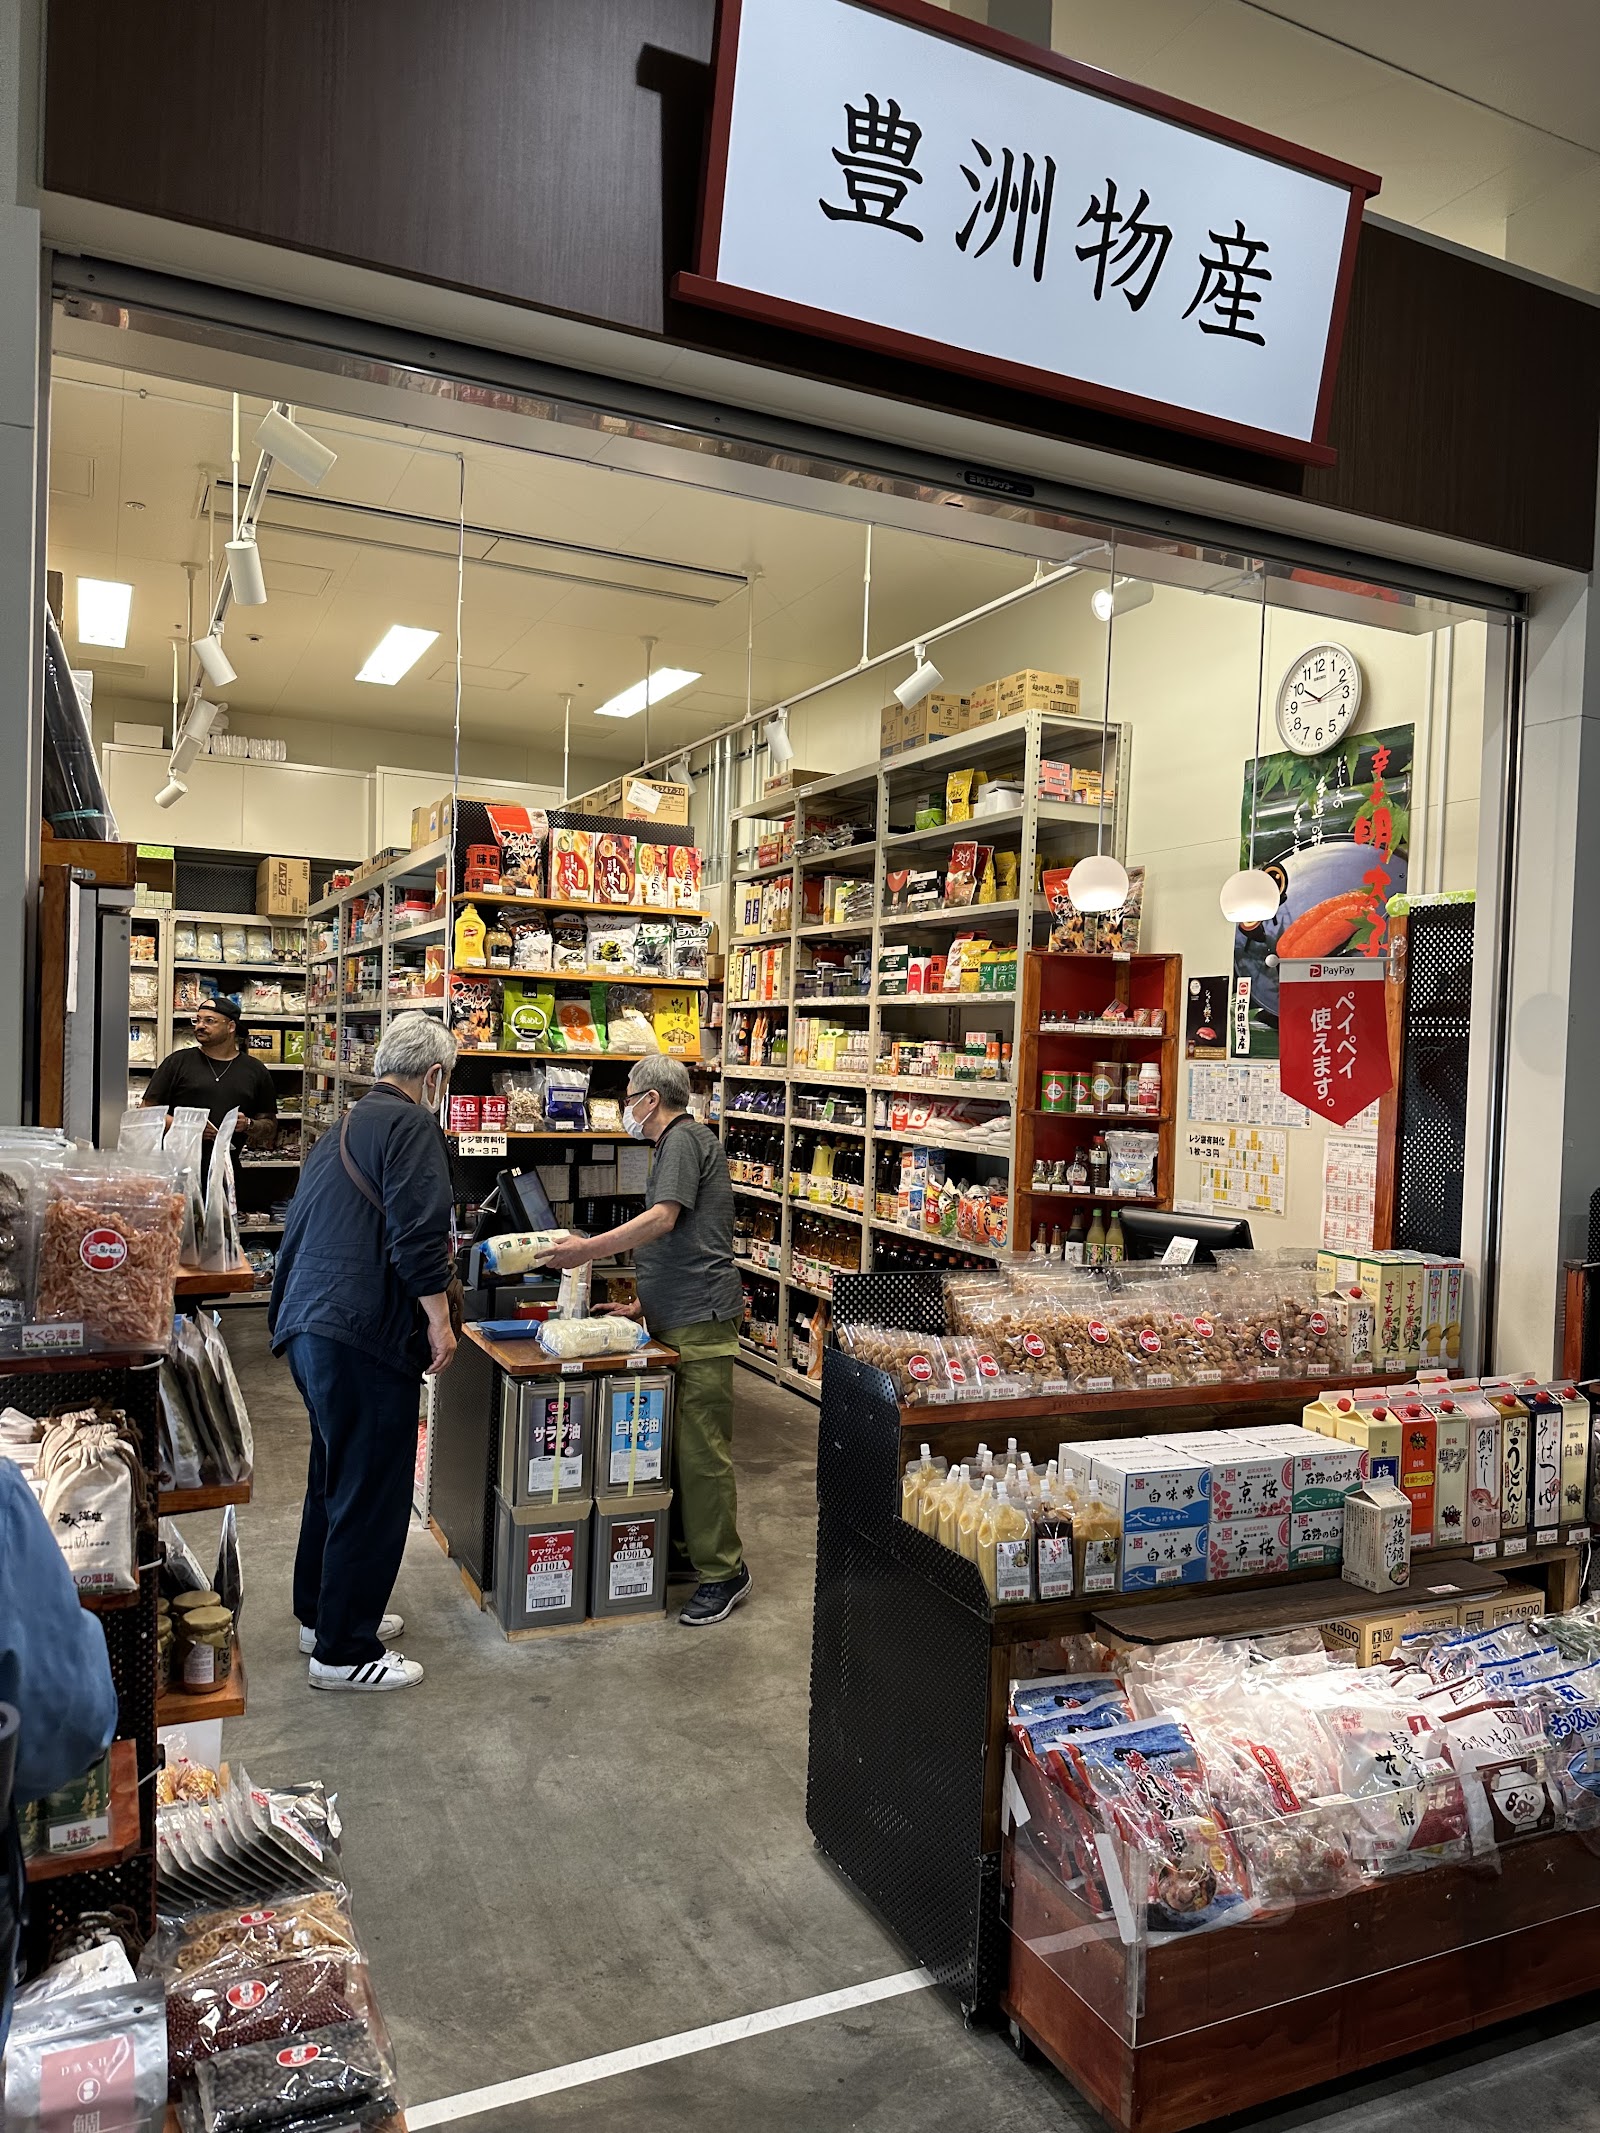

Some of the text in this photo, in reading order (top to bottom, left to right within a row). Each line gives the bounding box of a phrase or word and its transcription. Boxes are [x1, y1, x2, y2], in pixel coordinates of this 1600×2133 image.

[819, 93, 1272, 347] 豊洲物産
[1314, 658, 1325, 673] 12
[1331, 659, 1335, 672] 1
[1303, 667, 1311, 681] 11
[1339, 669, 1347, 682] 2
[1293, 682, 1304, 697] 10
[1342, 685, 1350, 698] 3
[1290, 701, 1298, 714] 9
[1338, 703, 1346, 716] 4
[1293, 717, 1301, 730] 8
[1328, 719, 1336, 732] 5
[1303, 726, 1310, 740] 7
[1315, 727, 1323, 740] 6
[1323, 965, 1355, 976] PayPay
[1335, 990, 1358, 1080] ペイペイ
[1310, 1007, 1336, 1107] 使えます。
[460, 1136, 506, 1144] レジ袋有料化
[1189, 1134, 1225, 1147] レジ袋有料化
[1382, 1281, 1394, 1345] すだち果汁
[1404, 1280, 1416, 1344] すだち果汁
[23, 1329, 81, 1342] さくら海老
[1565, 1443, 1584, 1457] 白湯
[1538, 1418, 1556, 1512] そばつゆ
[1149, 1485, 1195, 1503] 白味噌
[618, 1535, 649, 1543] ヤマサしょうゆ
[1392, 1514, 1406, 1561] 地鶏鍋
[531, 1546, 572, 1557] ヤマサしょうゆ
[543, 1554, 564, 1562] こいくち
[616, 1550, 649, 1560] 01901A
[1147, 1543, 1192, 1561] 白味噌
[533, 1562, 568, 1573] 01101A
[1161, 1569, 1178, 1579] 白味噌
[1005, 1589, 1024, 1597] 酢味噌
[1455, 1727, 1517, 1750] お吸いもの
